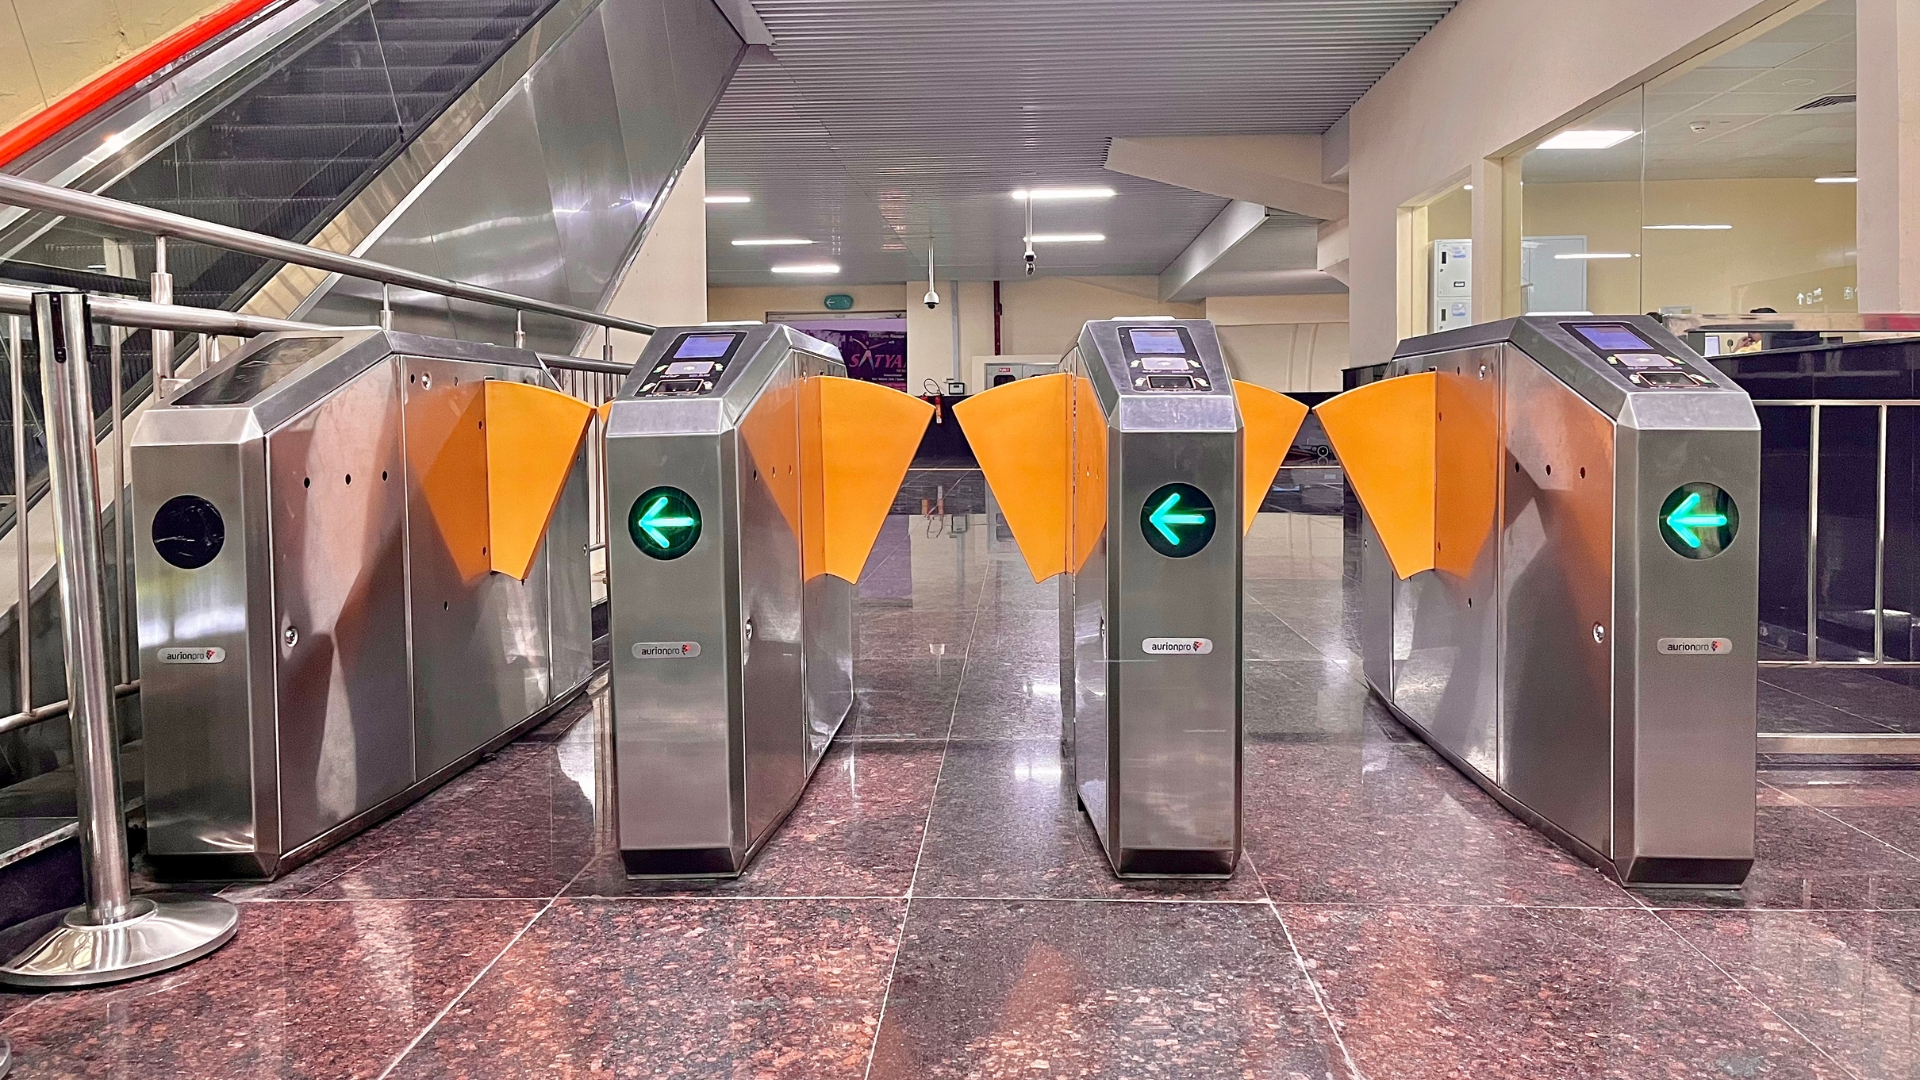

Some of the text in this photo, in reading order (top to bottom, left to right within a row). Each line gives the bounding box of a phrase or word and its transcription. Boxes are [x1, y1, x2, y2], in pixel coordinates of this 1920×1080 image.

[848, 350, 907, 371] SATYA
[641, 646, 680, 656] aurionpro
[1151, 641, 1192, 652] aurionpro
[1667, 642, 1709, 652] aurionpro
[166, 651, 205, 661] aurionpro
